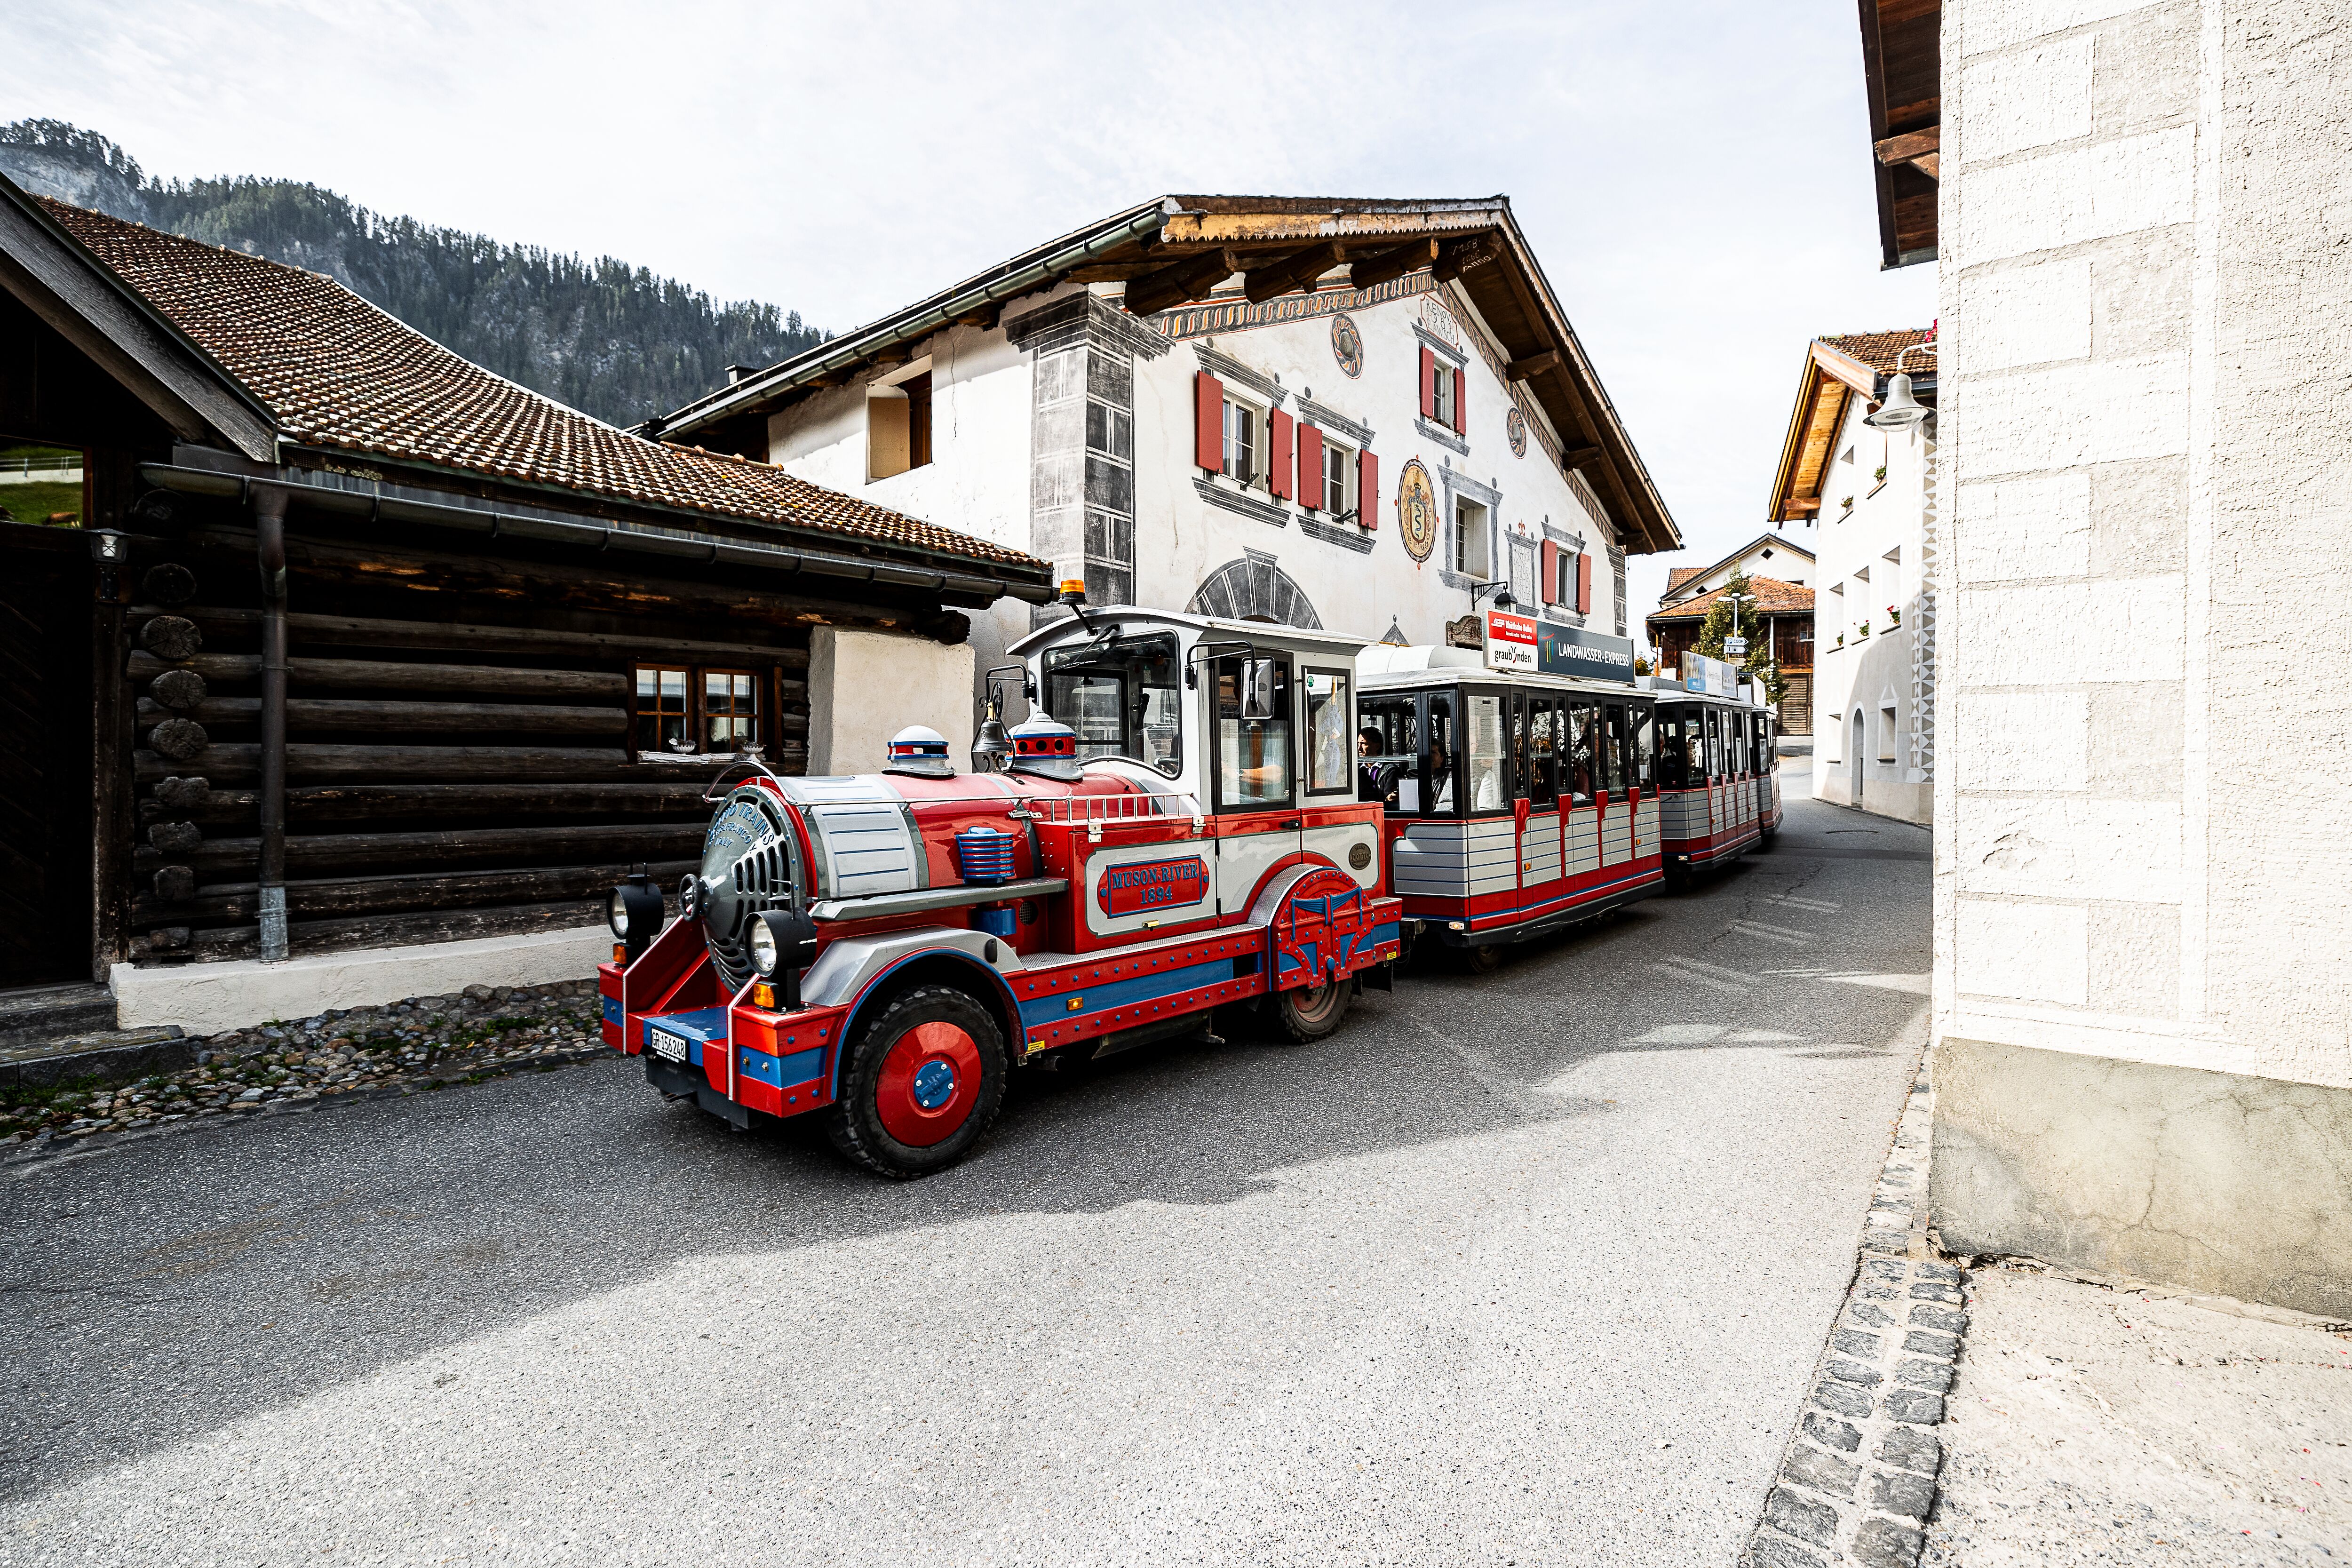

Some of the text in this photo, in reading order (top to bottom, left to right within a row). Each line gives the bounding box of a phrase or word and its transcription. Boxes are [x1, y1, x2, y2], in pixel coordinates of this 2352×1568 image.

[1558, 642, 1629, 667] LANDWASSER-EXPRESS
[739, 804, 774, 846] TRAINS
[1351, 852, 1369, 861] DOTTO
[1140, 885, 1172, 904] 1894
